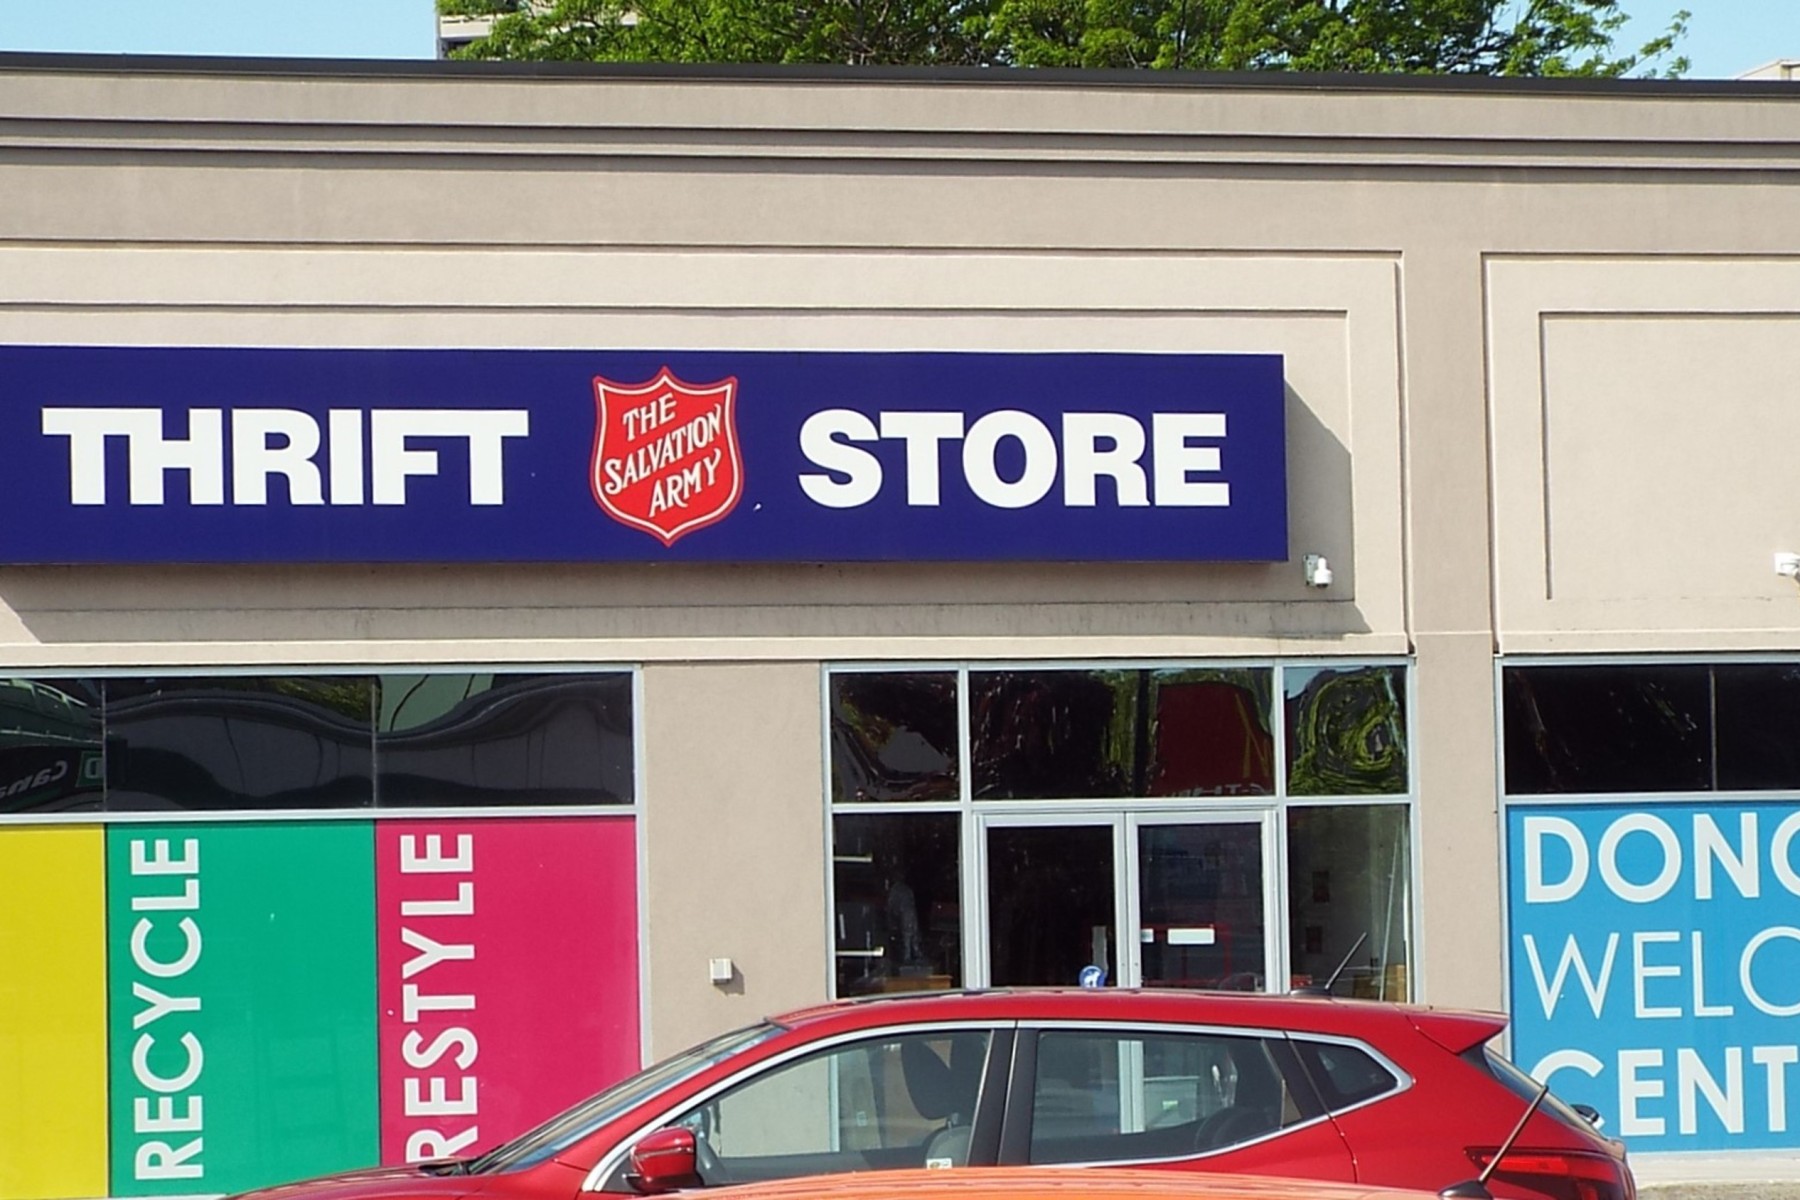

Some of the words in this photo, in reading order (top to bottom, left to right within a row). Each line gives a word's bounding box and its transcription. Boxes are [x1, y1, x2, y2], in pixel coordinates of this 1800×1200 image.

[42, 407, 529, 505] THRIFT
[798, 409, 1230, 508] STORE
[604, 403, 722, 495] SALVATION
[622, 392, 677, 442] THE
[648, 448, 722, 518] ARMY
[131, 839, 203, 1181] RECYCLE
[400, 834, 478, 1164] RESTYLE
